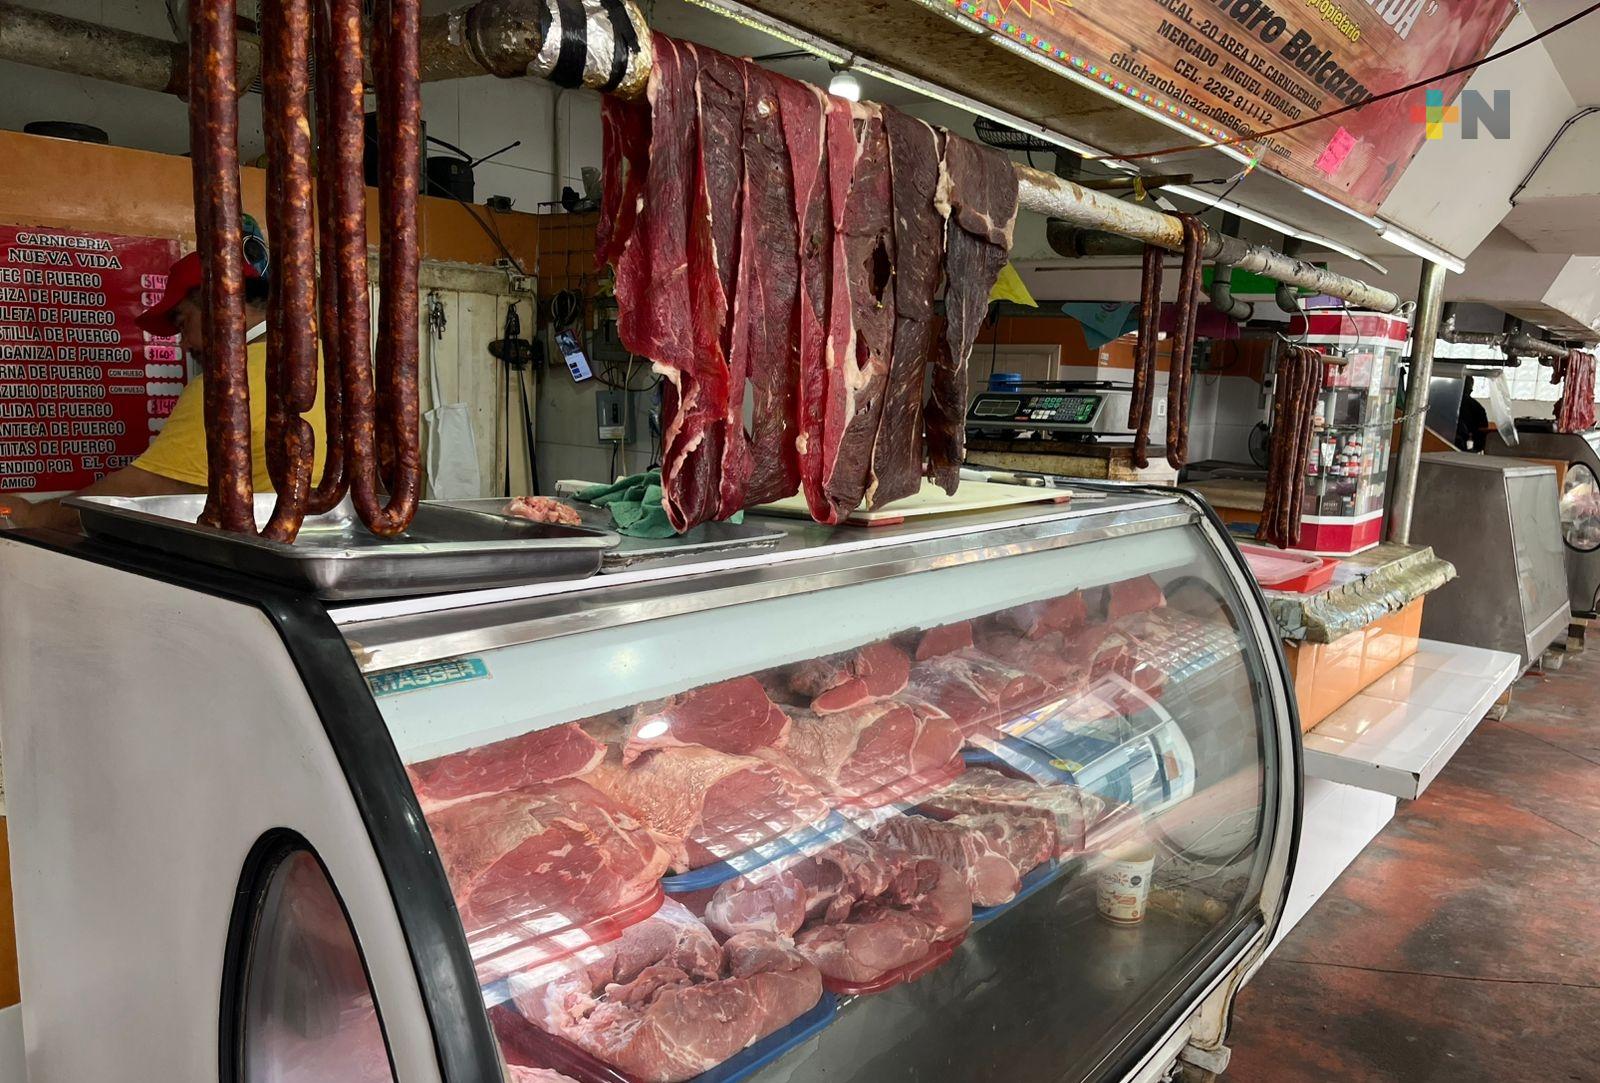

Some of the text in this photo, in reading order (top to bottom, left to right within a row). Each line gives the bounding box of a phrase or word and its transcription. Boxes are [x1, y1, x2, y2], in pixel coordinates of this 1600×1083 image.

[1157, 19, 1301, 120] MERCADO MIGUEL HIDALGO
[1219, 33, 1249, 63] AREA
[1250, 54, 1266, 73] DE
[1264, 65, 1322, 111] CARNICERIAS
[1174, 59, 1273, 125] CEL: 2292 811112
[8, 248, 122, 270] NUEVA VIDA
[23, 269, 43, 285] DE
[46, 271, 102, 288] PUERCO
[29, 289, 48, 304] DE
[51, 290, 106, 306] PUERCO
[0, 306, 115, 325] LETA DE PUERCO
[44, 327, 63, 342] DE
[65, 328, 120, 344] PUERCO
[0, 345, 132, 363] GANIZA DE PUERCO
[29, 365, 47, 379] DE
[50, 366, 103, 380] PUERCO
[0, 384, 40, 399] ZUELO
[41, 385, 58, 399] DE
[60, 385, 106, 399] PUERCO
[0, 403, 113, 418] LIDA DE PUERCO
[0, 421, 126, 437] NTECA DE PUERCO
[40, 441, 60, 456] DE
[62, 440, 116, 455] PUERCO
[47, 459, 73, 472] POR
[81, 455, 105, 470] EL
[1, 477, 36, 490] AMIGO
